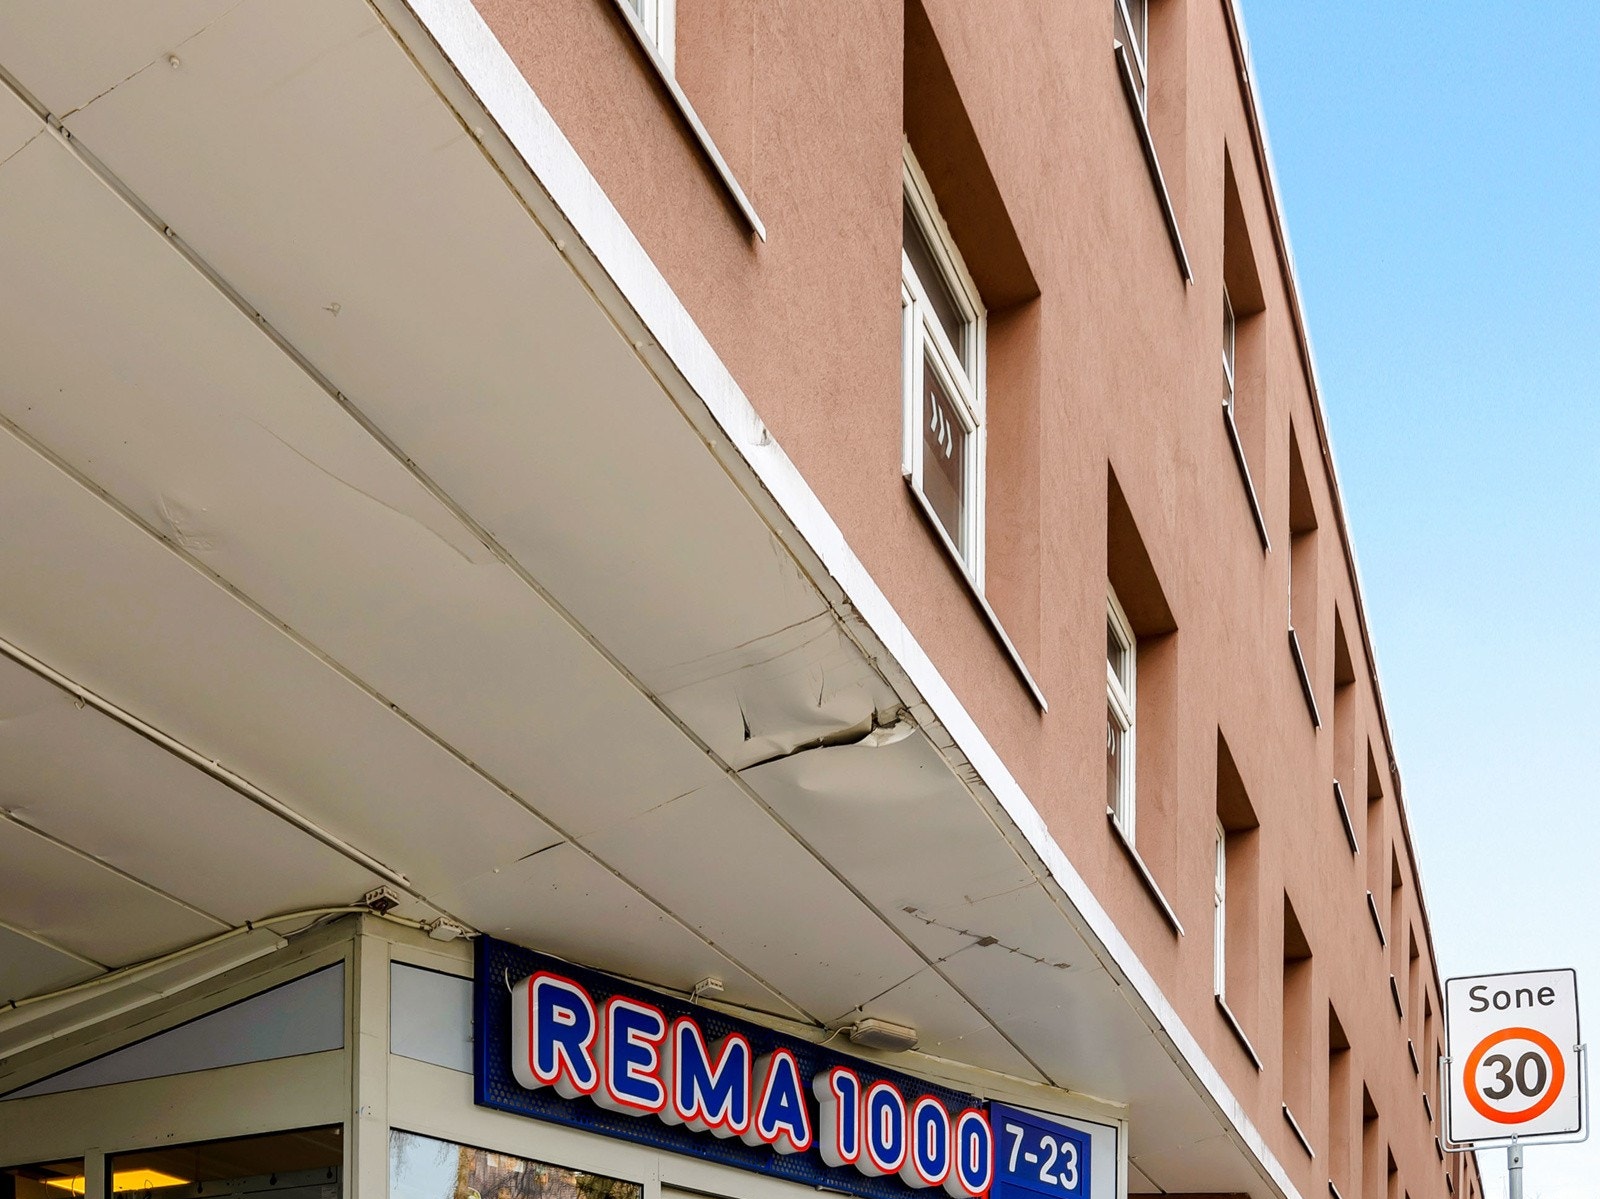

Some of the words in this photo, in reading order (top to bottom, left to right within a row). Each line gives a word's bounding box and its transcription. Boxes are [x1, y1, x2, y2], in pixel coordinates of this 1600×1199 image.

[1469, 985, 1555, 1012] Sone
[527, 969, 813, 1153] REMA
[828, 1064, 995, 1198] 1000
[1482, 1051, 1547, 1100] 30
[1005, 1122, 1079, 1191] 7-23
